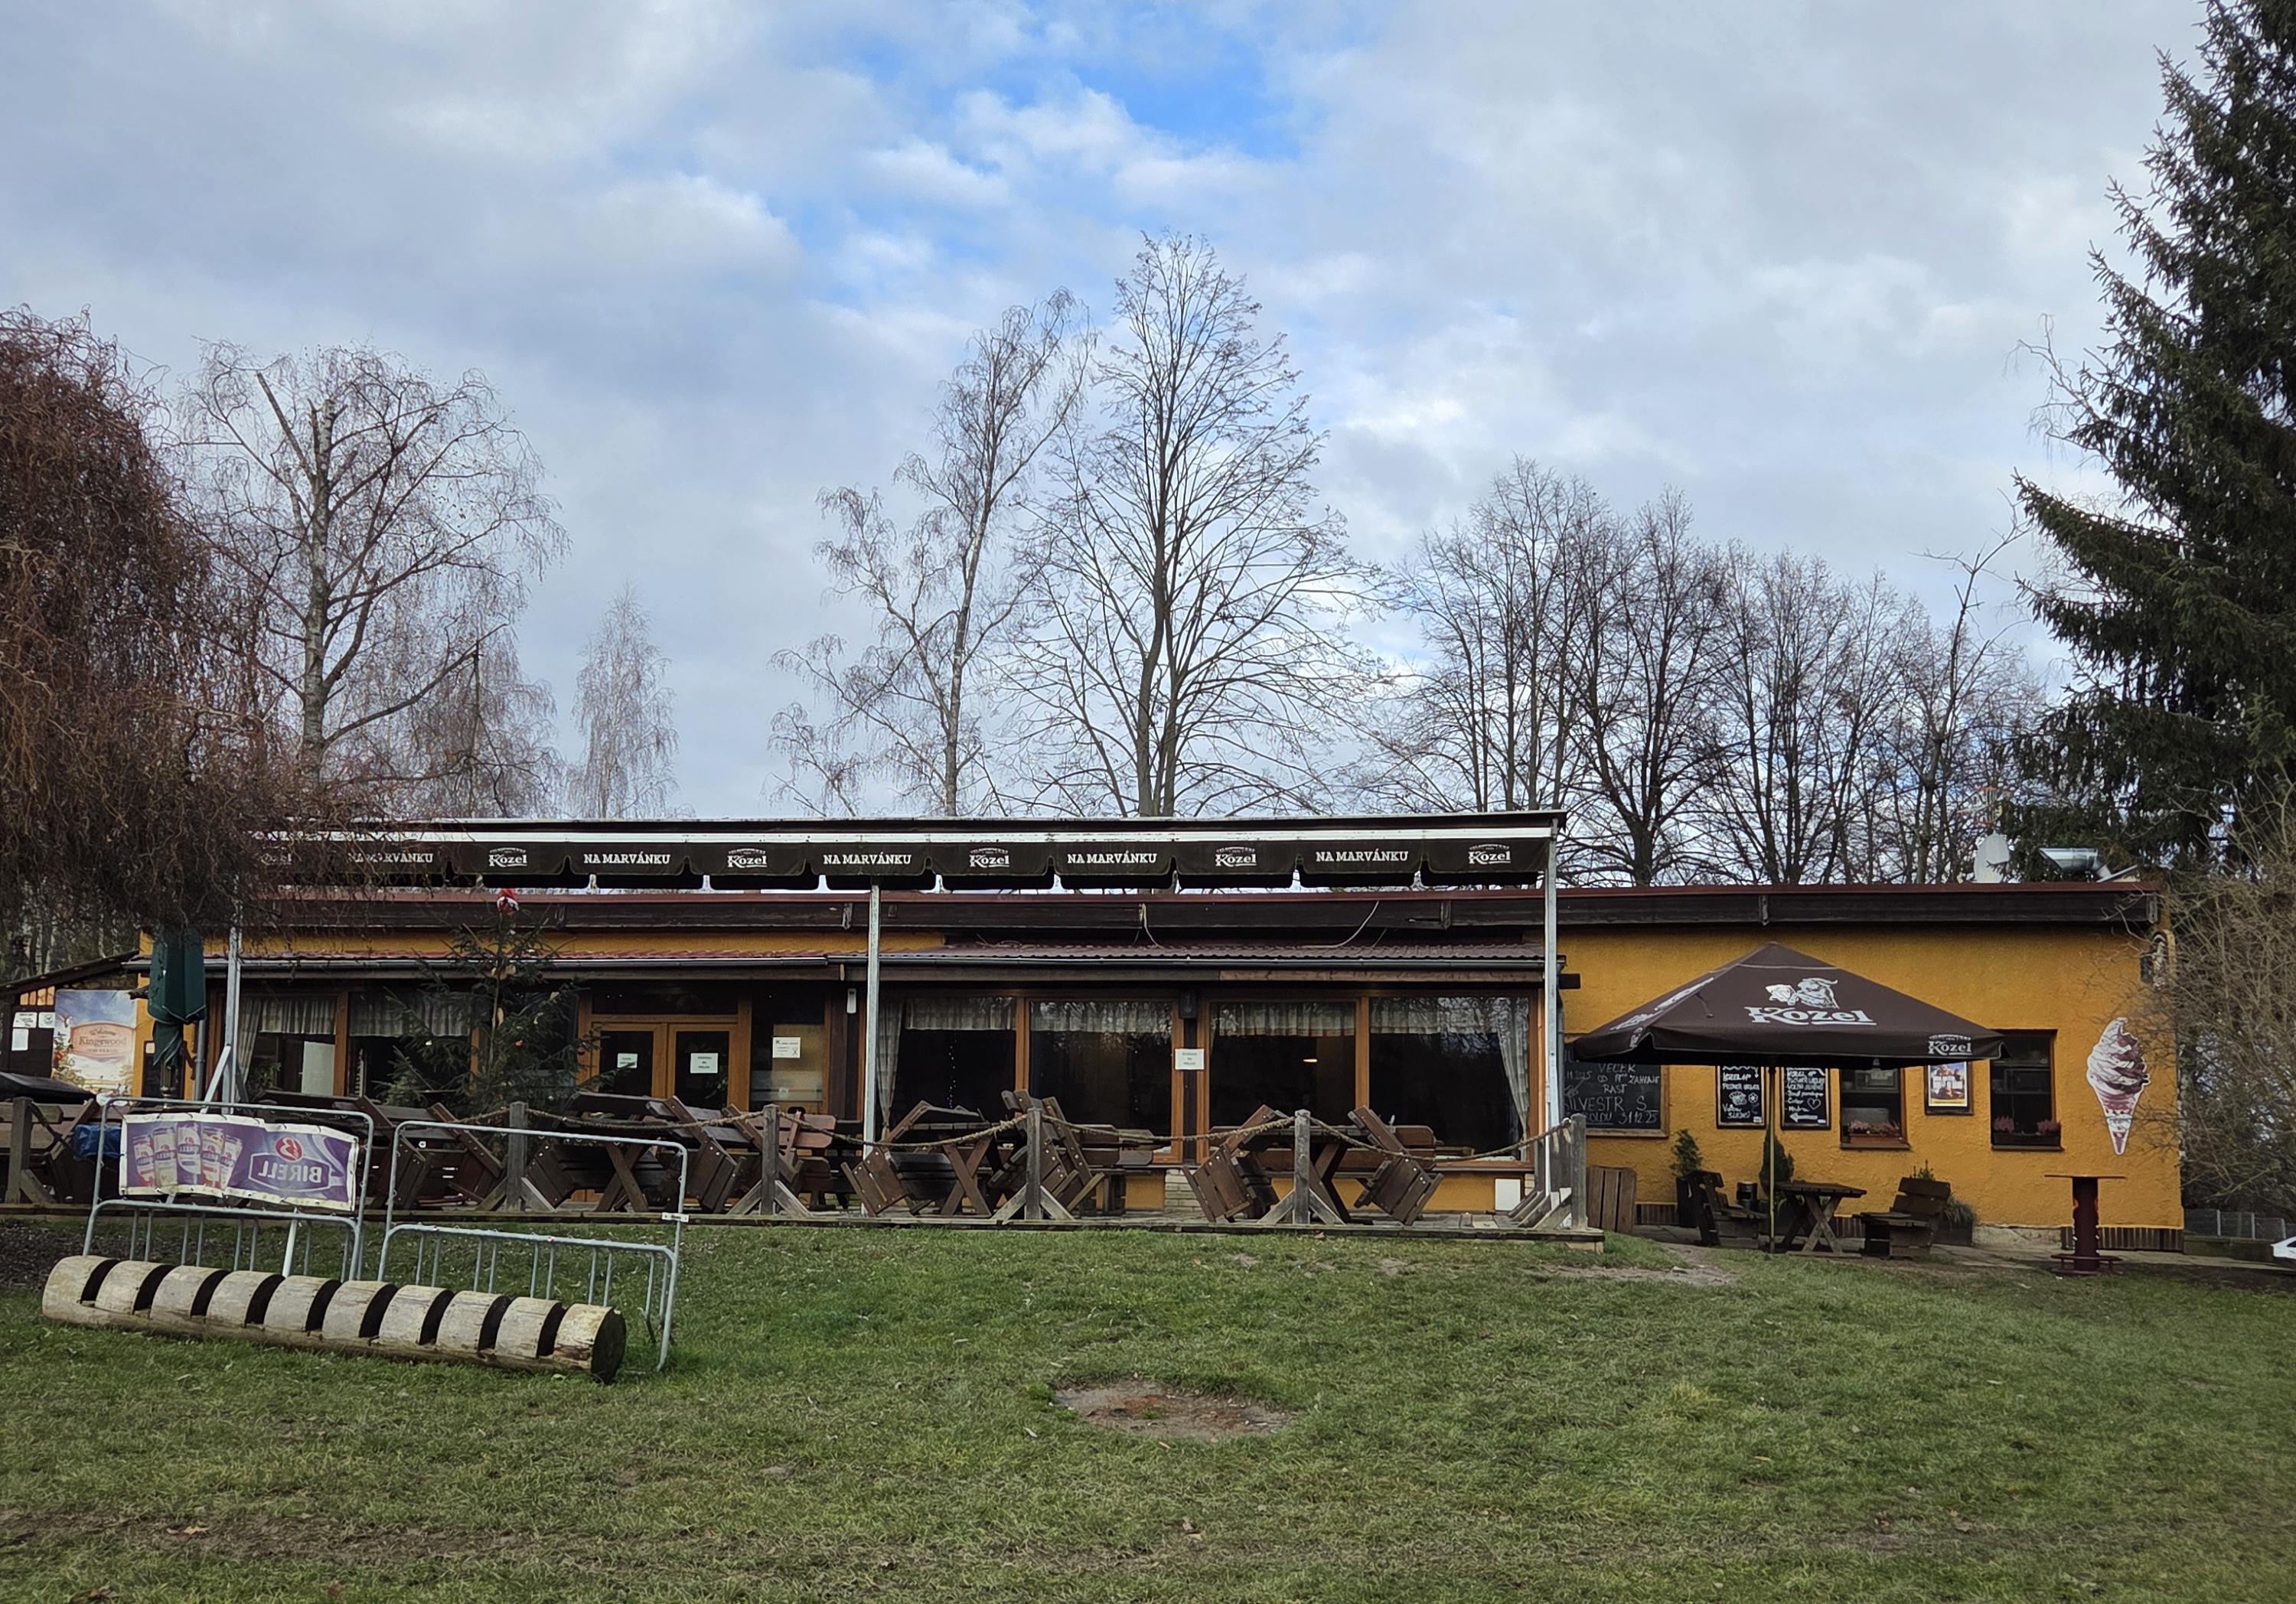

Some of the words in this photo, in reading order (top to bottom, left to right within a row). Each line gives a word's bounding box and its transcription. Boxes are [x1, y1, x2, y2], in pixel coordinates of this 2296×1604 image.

[489, 854, 527, 867] Kozel
[584, 854, 601, 864] NA
[602, 851, 670, 864] MARVÁNKU
[728, 856, 767, 868] Kozel
[823, 855, 840, 864] NA
[843, 852, 912, 864] MARVÁNKU
[970, 855, 1009, 868] Kozel
[1068, 853, 1084, 863] NA
[1087, 851, 1157, 863] MARVÁNKU
[1215, 853, 1257, 867] Kozel
[1316, 851, 1334, 862] NA
[1336, 849, 1408, 862] MARVÁNKU
[1468, 851, 1511, 864] Kozel
[1743, 1006, 1877, 1025] Kozel
[1928, 1041, 1972, 1055] Kozel
[1603, 1084, 1627, 1094] RAST
